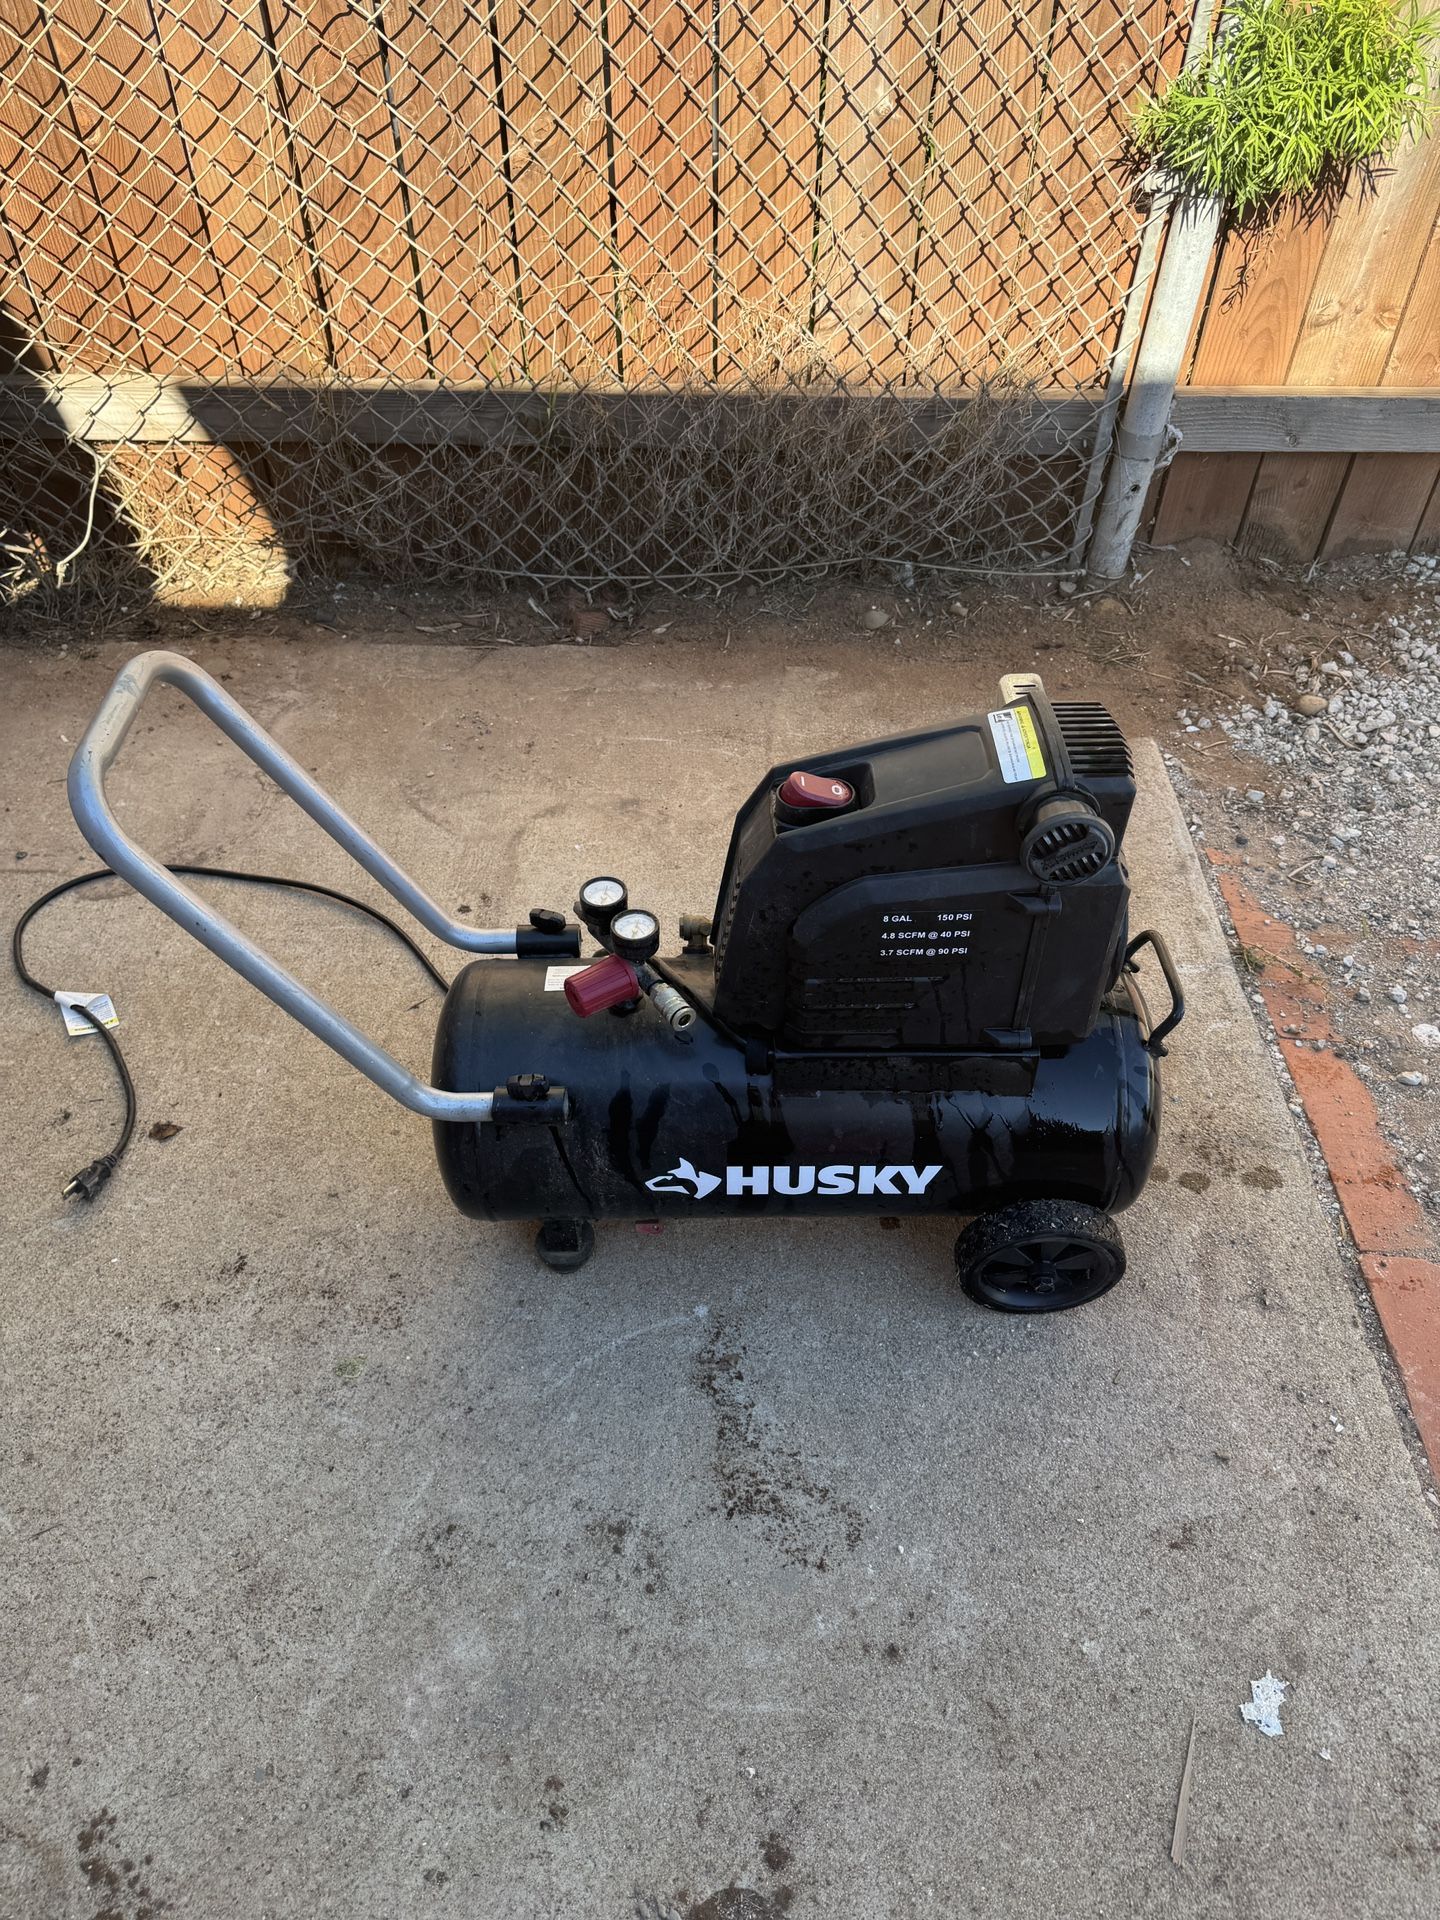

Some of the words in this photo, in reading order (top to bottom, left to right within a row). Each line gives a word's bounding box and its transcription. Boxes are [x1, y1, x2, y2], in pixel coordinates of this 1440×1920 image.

[956, 913, 973, 921] PSI
[928, 931, 939, 940] @
[896, 948, 924, 956] SCFM
[925, 948, 936, 957] @
[726, 1164, 944, 1196] HUSKY
